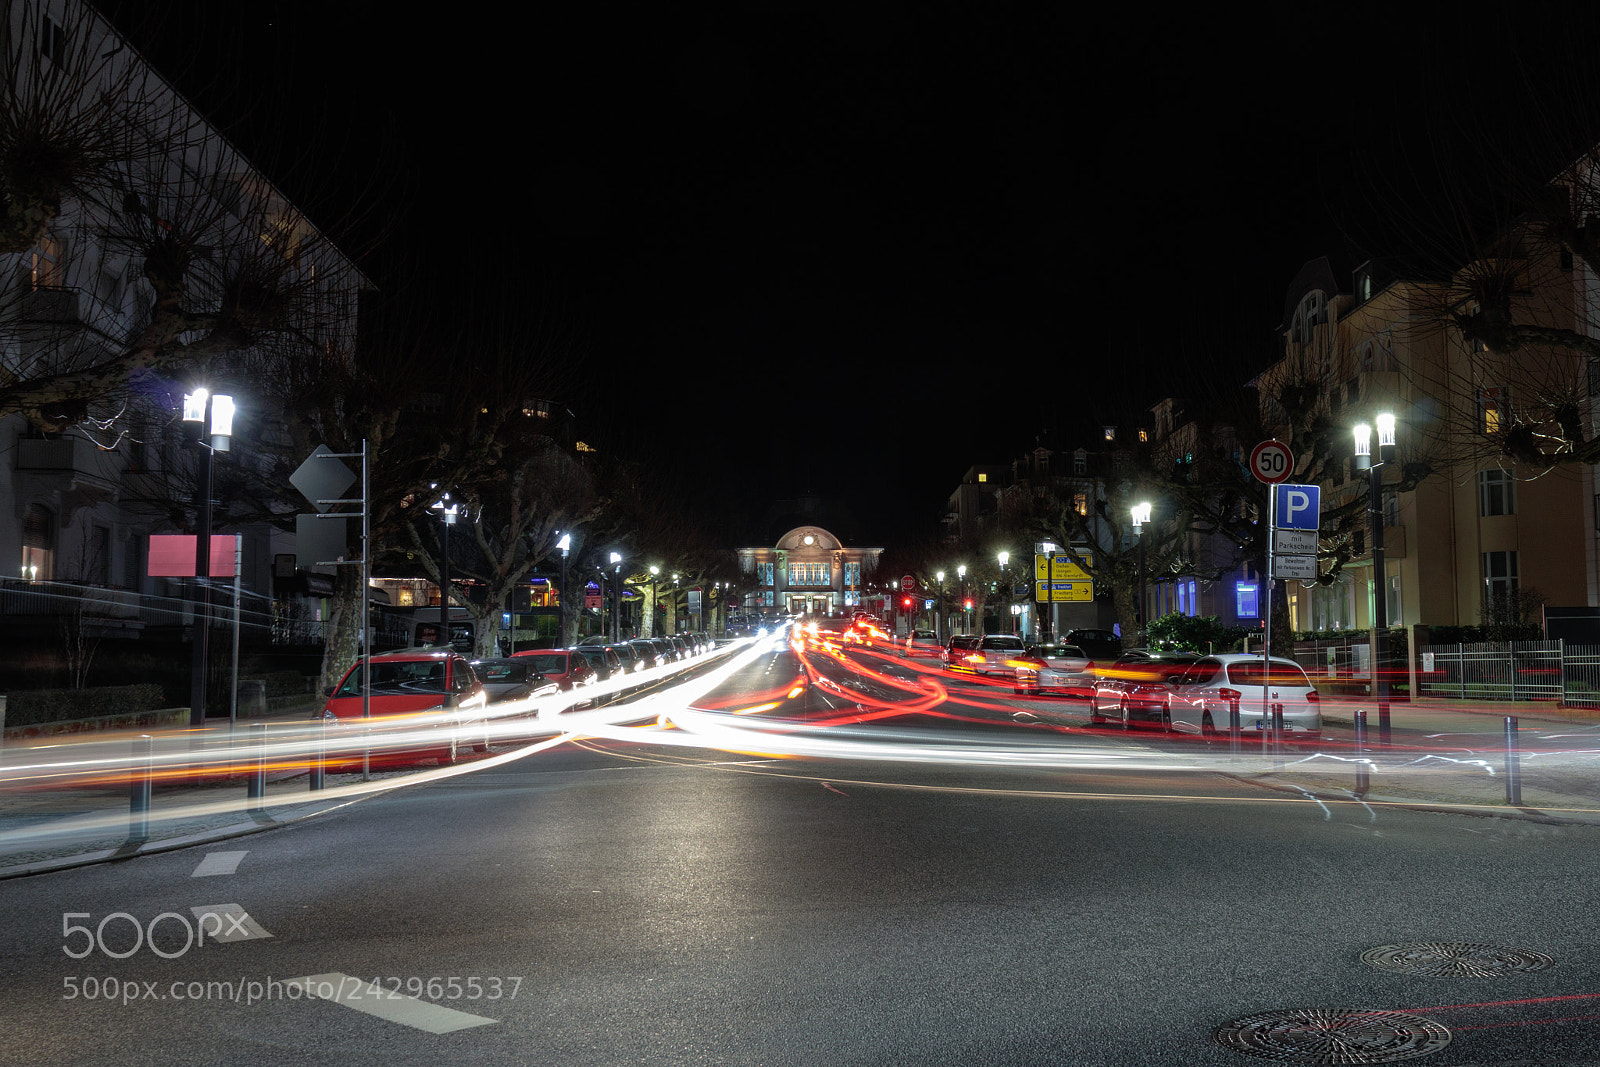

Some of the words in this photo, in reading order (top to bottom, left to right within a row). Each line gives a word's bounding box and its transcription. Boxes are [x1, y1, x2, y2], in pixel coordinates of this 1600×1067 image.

[1260, 452, 1284, 473] 50
[1286, 490, 1310, 524] P
[1278, 541, 1314, 550] Parkschein
